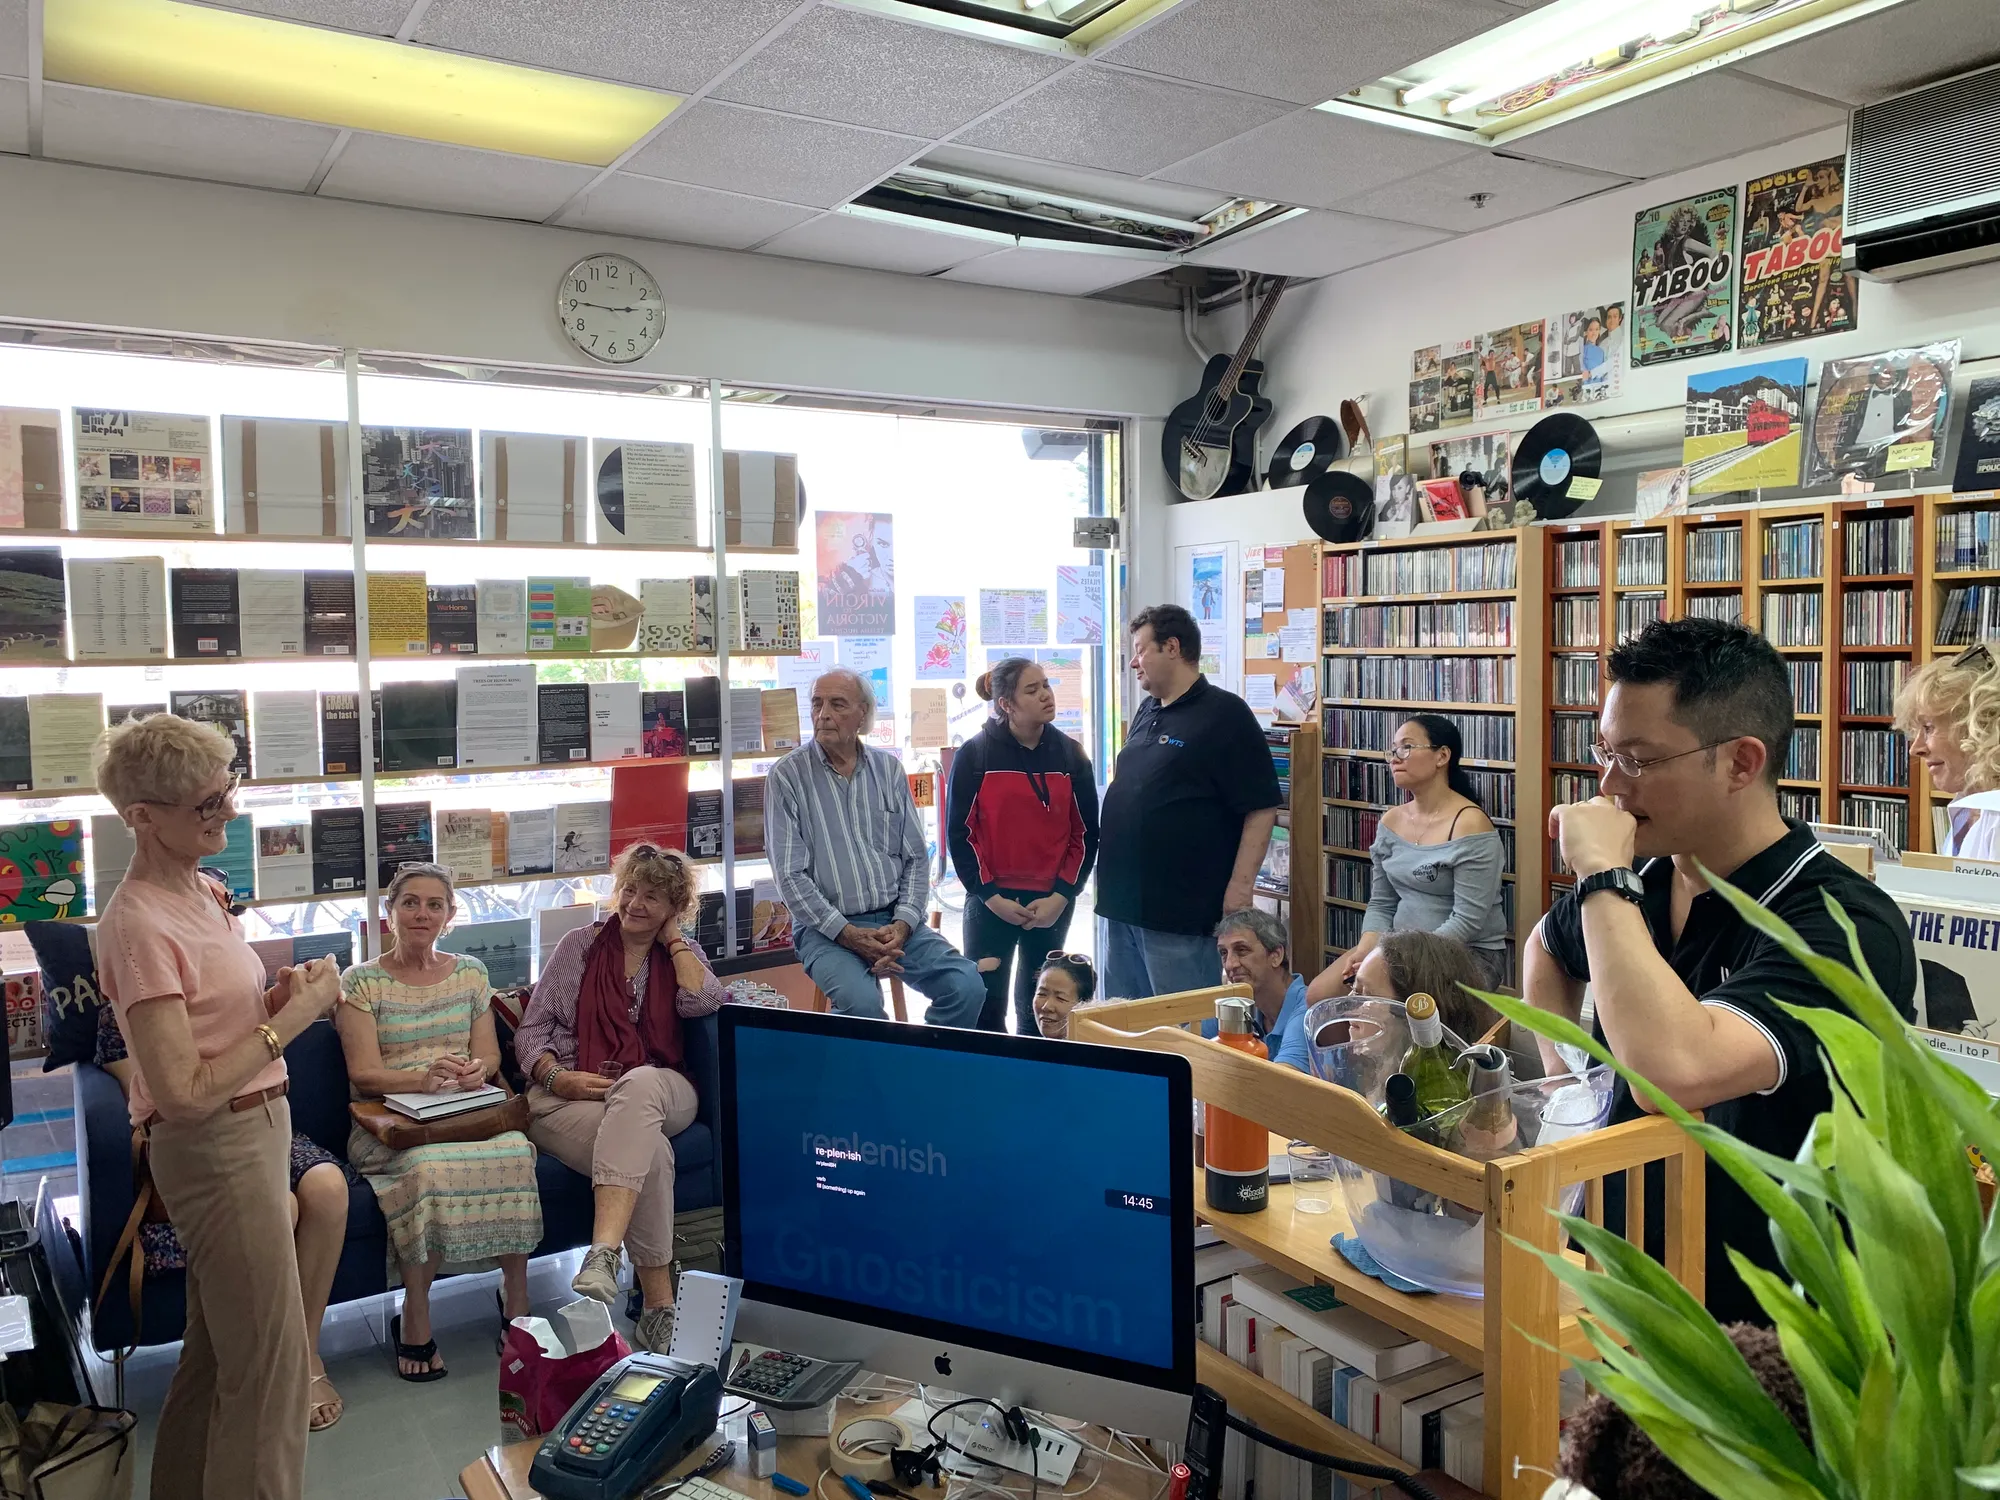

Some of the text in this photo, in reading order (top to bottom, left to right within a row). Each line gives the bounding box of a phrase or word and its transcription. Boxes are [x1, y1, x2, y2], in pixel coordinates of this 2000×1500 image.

[590, 268, 599, 280] 11
[606, 265, 618, 278] 12
[629, 272, 633, 285] 1
[1634, 252, 1731, 310] TABOO
[1744, 277, 1780, 292] Barcelona
[575, 280, 586, 292] 10
[640, 288, 647, 300] 2
[570, 299, 578, 311] 9
[646, 309, 653, 321] 3
[577, 318, 585, 331] 8
[640, 326, 647, 338] 4
[590, 334, 598, 347] 7
[627, 339, 635, 351] 5
[608, 342, 616, 354] 6
[91, 425, 124, 436] Replay
[1955, 866, 2000, 877] Rock/Po
[1910, 910, 1945, 943] THE
[50, 974, 99, 1020] PA
[1966, 1046, 1978, 1056] to
[1982, 1048, 1989, 1057] P
[802, 1132, 946, 1176] replenish
[1122, 1194, 1154, 1210] 14:45
[772, 1221, 1123, 1346] Gnosticism
